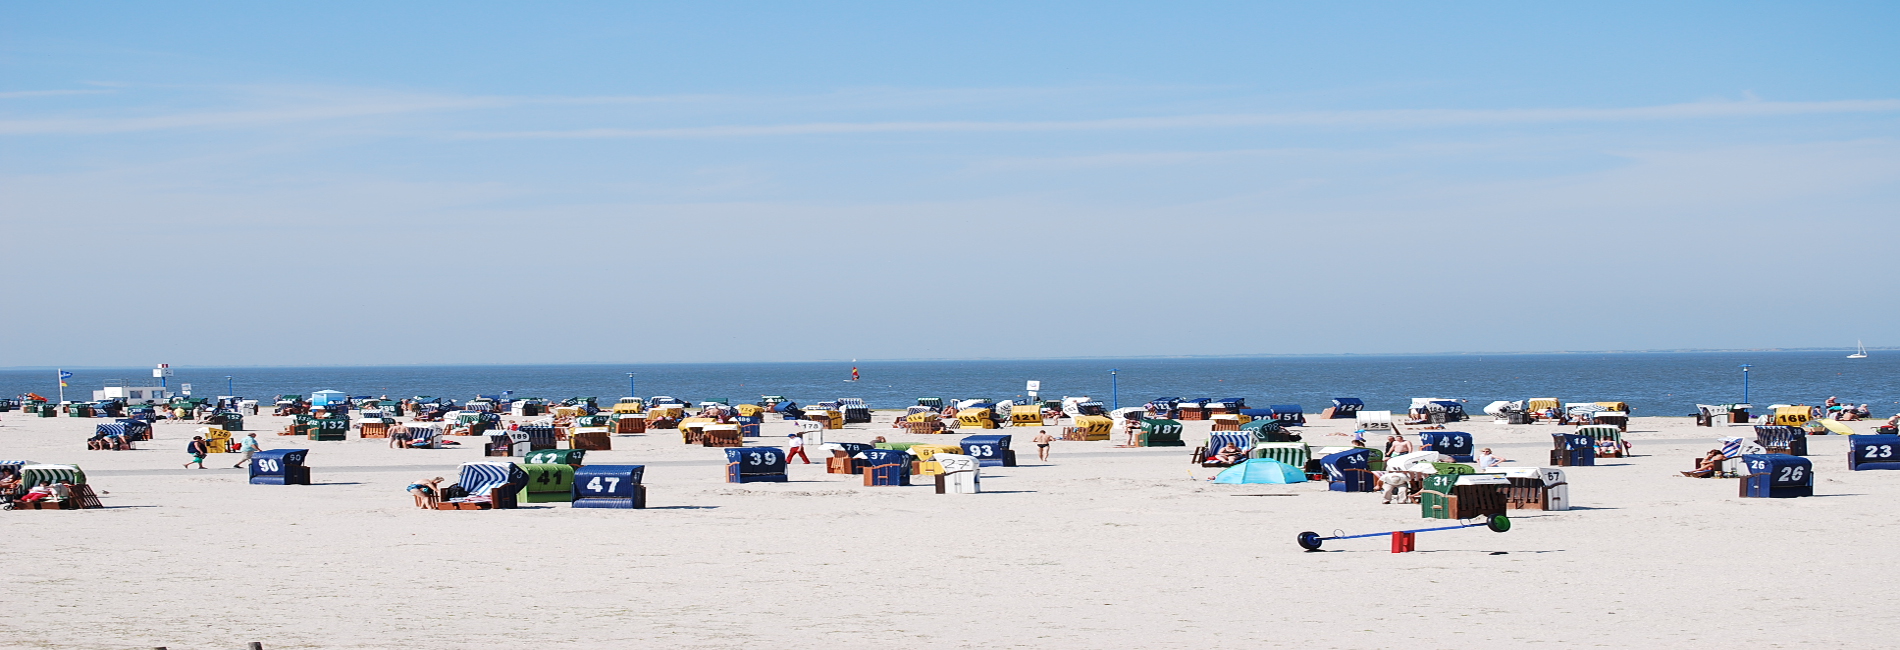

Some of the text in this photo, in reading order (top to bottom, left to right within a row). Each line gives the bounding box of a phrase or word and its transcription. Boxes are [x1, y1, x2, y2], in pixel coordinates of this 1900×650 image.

[960, 416, 979, 424] 193
[1778, 414, 1808, 422] 168
[320, 421, 346, 430] 132
[1089, 422, 1111, 432] 171
[1153, 425, 1182, 434] 187
[1439, 436, 1465, 448] 43
[870, 452, 888, 460] 37
[969, 444, 994, 457] 93
[1864, 445, 1892, 458] 23
[750, 452, 776, 466] 39
[941, 459, 970, 470] 27
[1348, 456, 1366, 466] 34
[258, 458, 279, 472] 90
[1751, 460, 1766, 470] 26
[511, 466, 524, 479] 73
[536, 470, 562, 485] 41
[1777, 466, 1804, 482] 26
[586, 476, 620, 492] 47
[1434, 476, 1448, 486] 31
